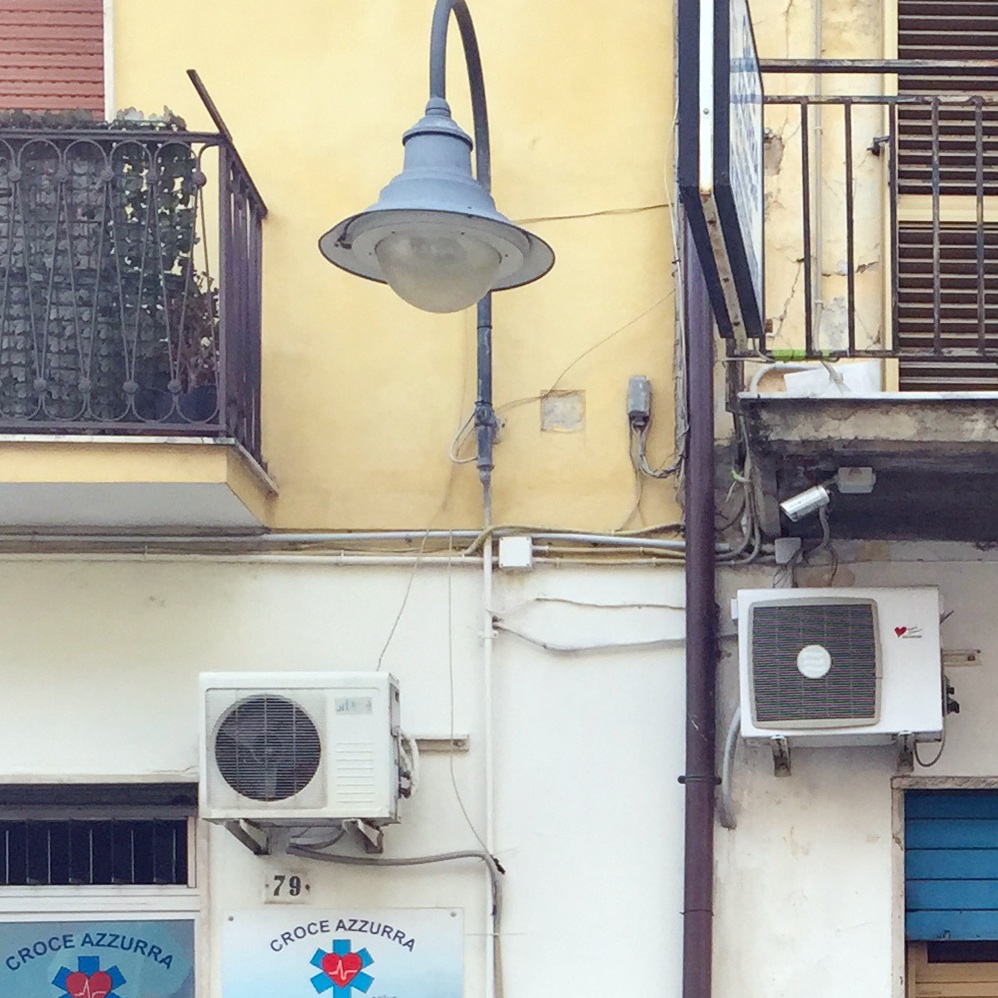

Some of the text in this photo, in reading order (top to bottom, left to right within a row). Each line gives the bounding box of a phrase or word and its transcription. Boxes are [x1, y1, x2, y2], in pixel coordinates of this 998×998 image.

[273, 875, 301, 896] 79
[5, 932, 173, 971] CROCE AZZURRA
[270, 918, 416, 952] CROCE AZZURRA
